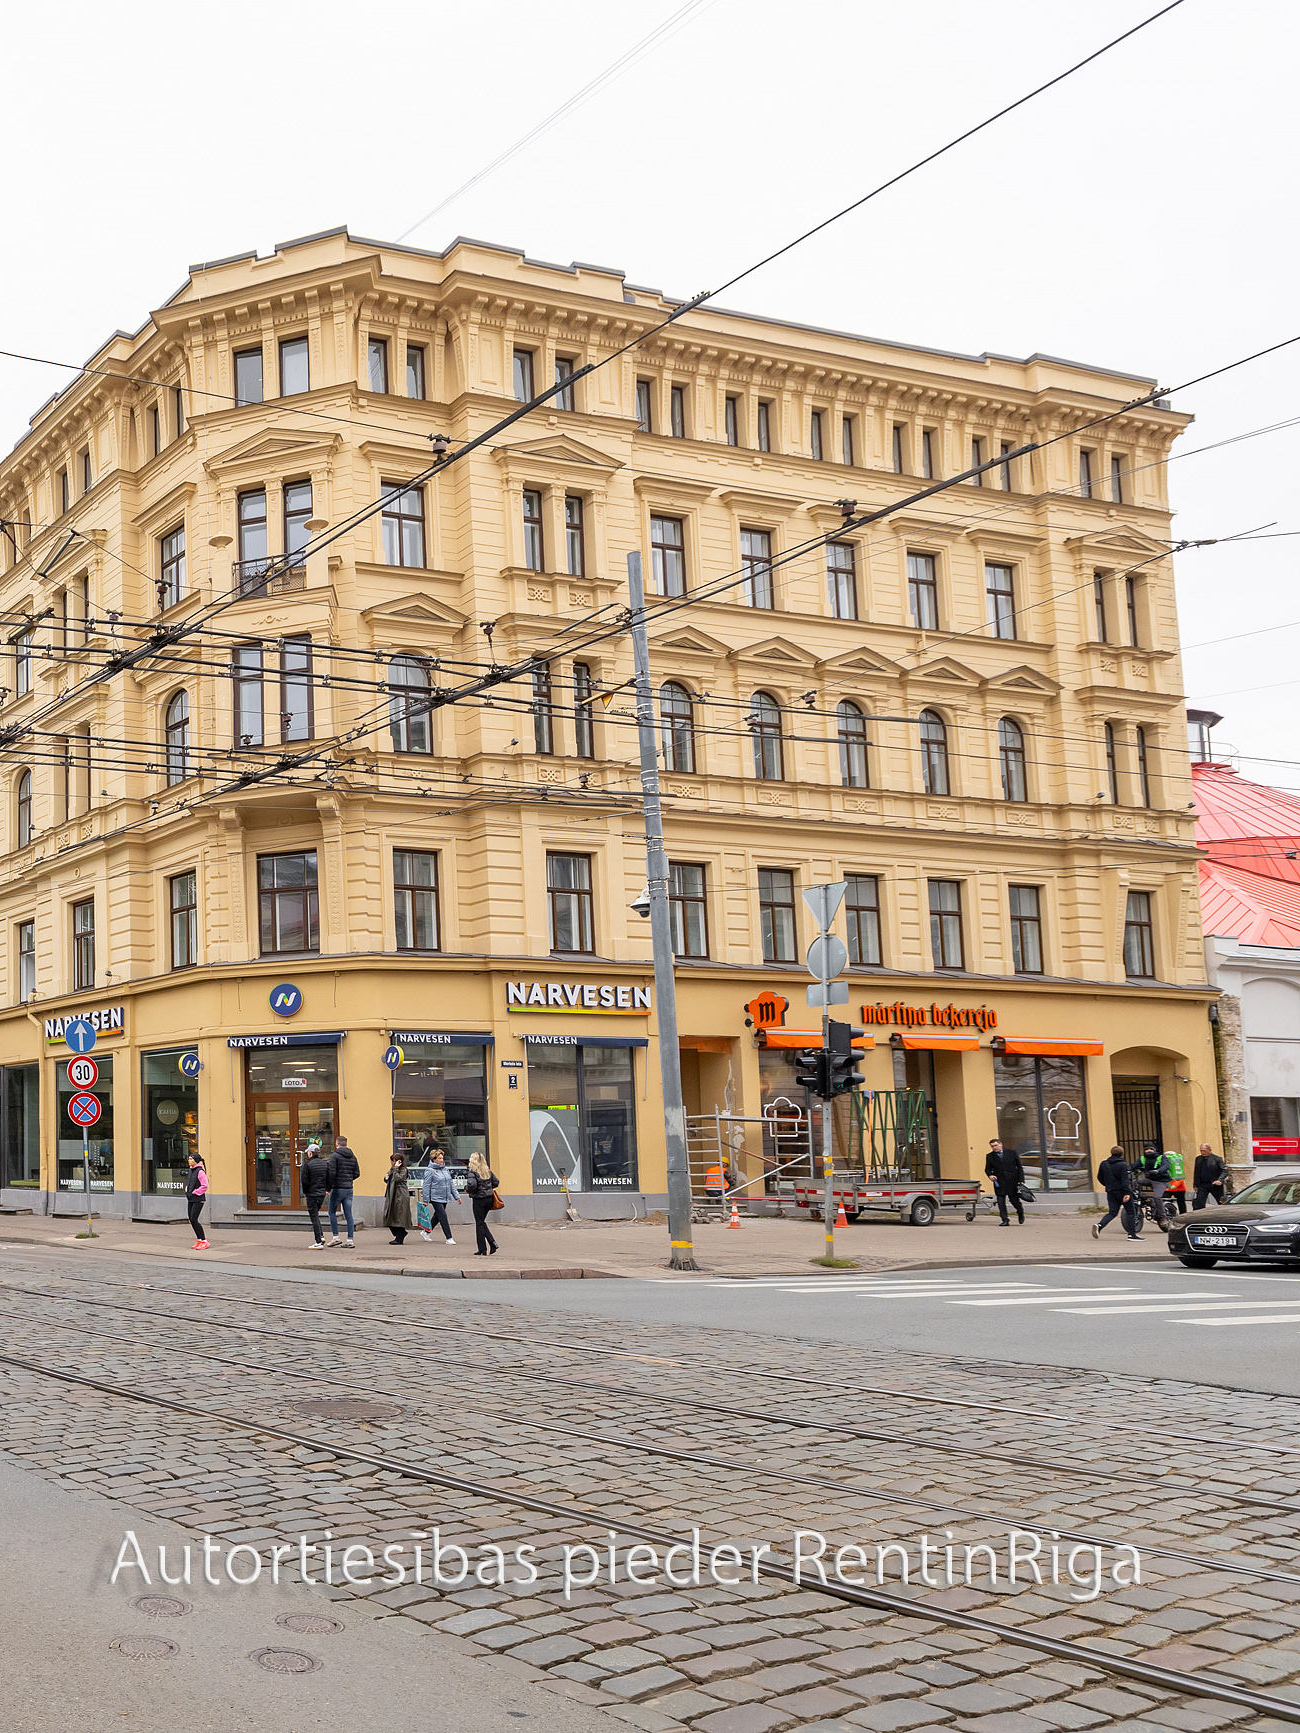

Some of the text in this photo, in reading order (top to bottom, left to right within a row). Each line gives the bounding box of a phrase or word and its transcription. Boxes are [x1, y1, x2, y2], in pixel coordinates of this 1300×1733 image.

[506, 982, 652, 1008] NARVESEN
[861, 1001, 928, 1029] mārtiņa
[229, 1036, 289, 1047] NARVESEN
[399, 1034, 451, 1044] NARVESEN
[527, 1036, 578, 1045] NARVESEN
[75, 1064, 91, 1081] 30
[510, 1076, 516, 1084] 2
